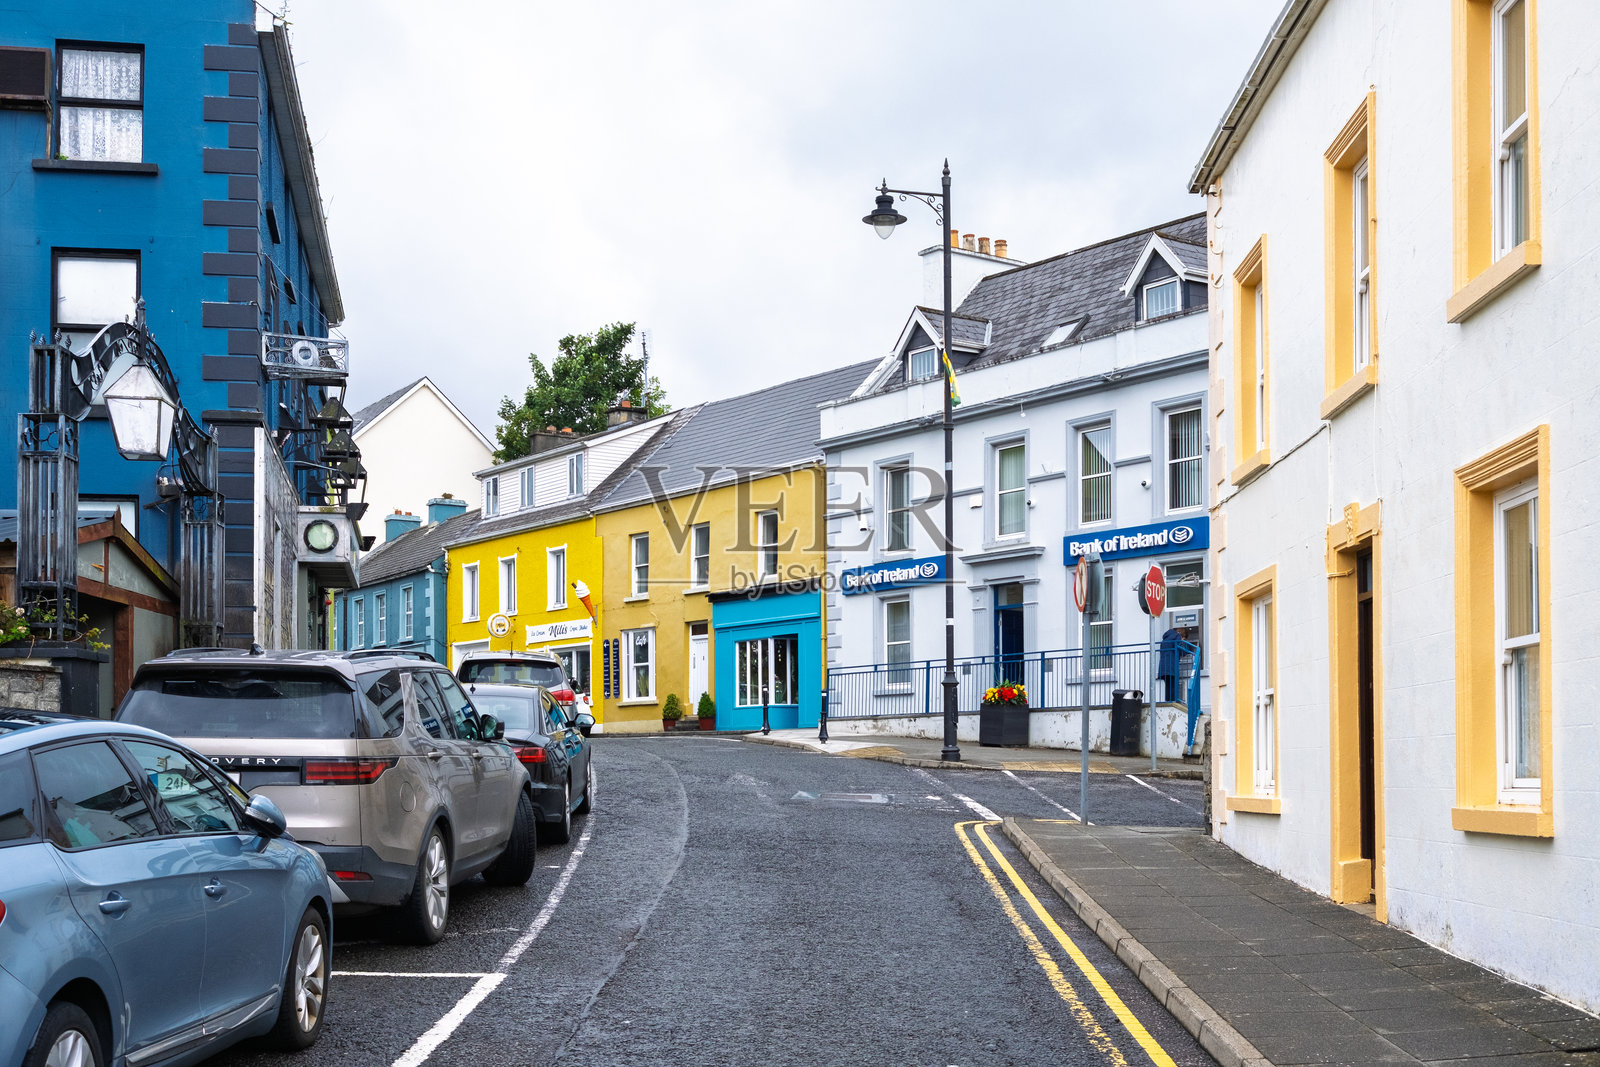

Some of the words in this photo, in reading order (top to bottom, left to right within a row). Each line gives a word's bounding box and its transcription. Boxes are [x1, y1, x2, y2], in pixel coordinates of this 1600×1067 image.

[1069, 539, 1104, 556] Bank
[1104, 535, 1120, 552] of
[1120, 529, 1168, 551] Ireland
[846, 572, 871, 588] Bank
[871, 570, 884, 585] of
[884, 564, 920, 583] Ireland
[1147, 580, 1165, 601] STOP
[210, 757, 281, 765] OVERY
